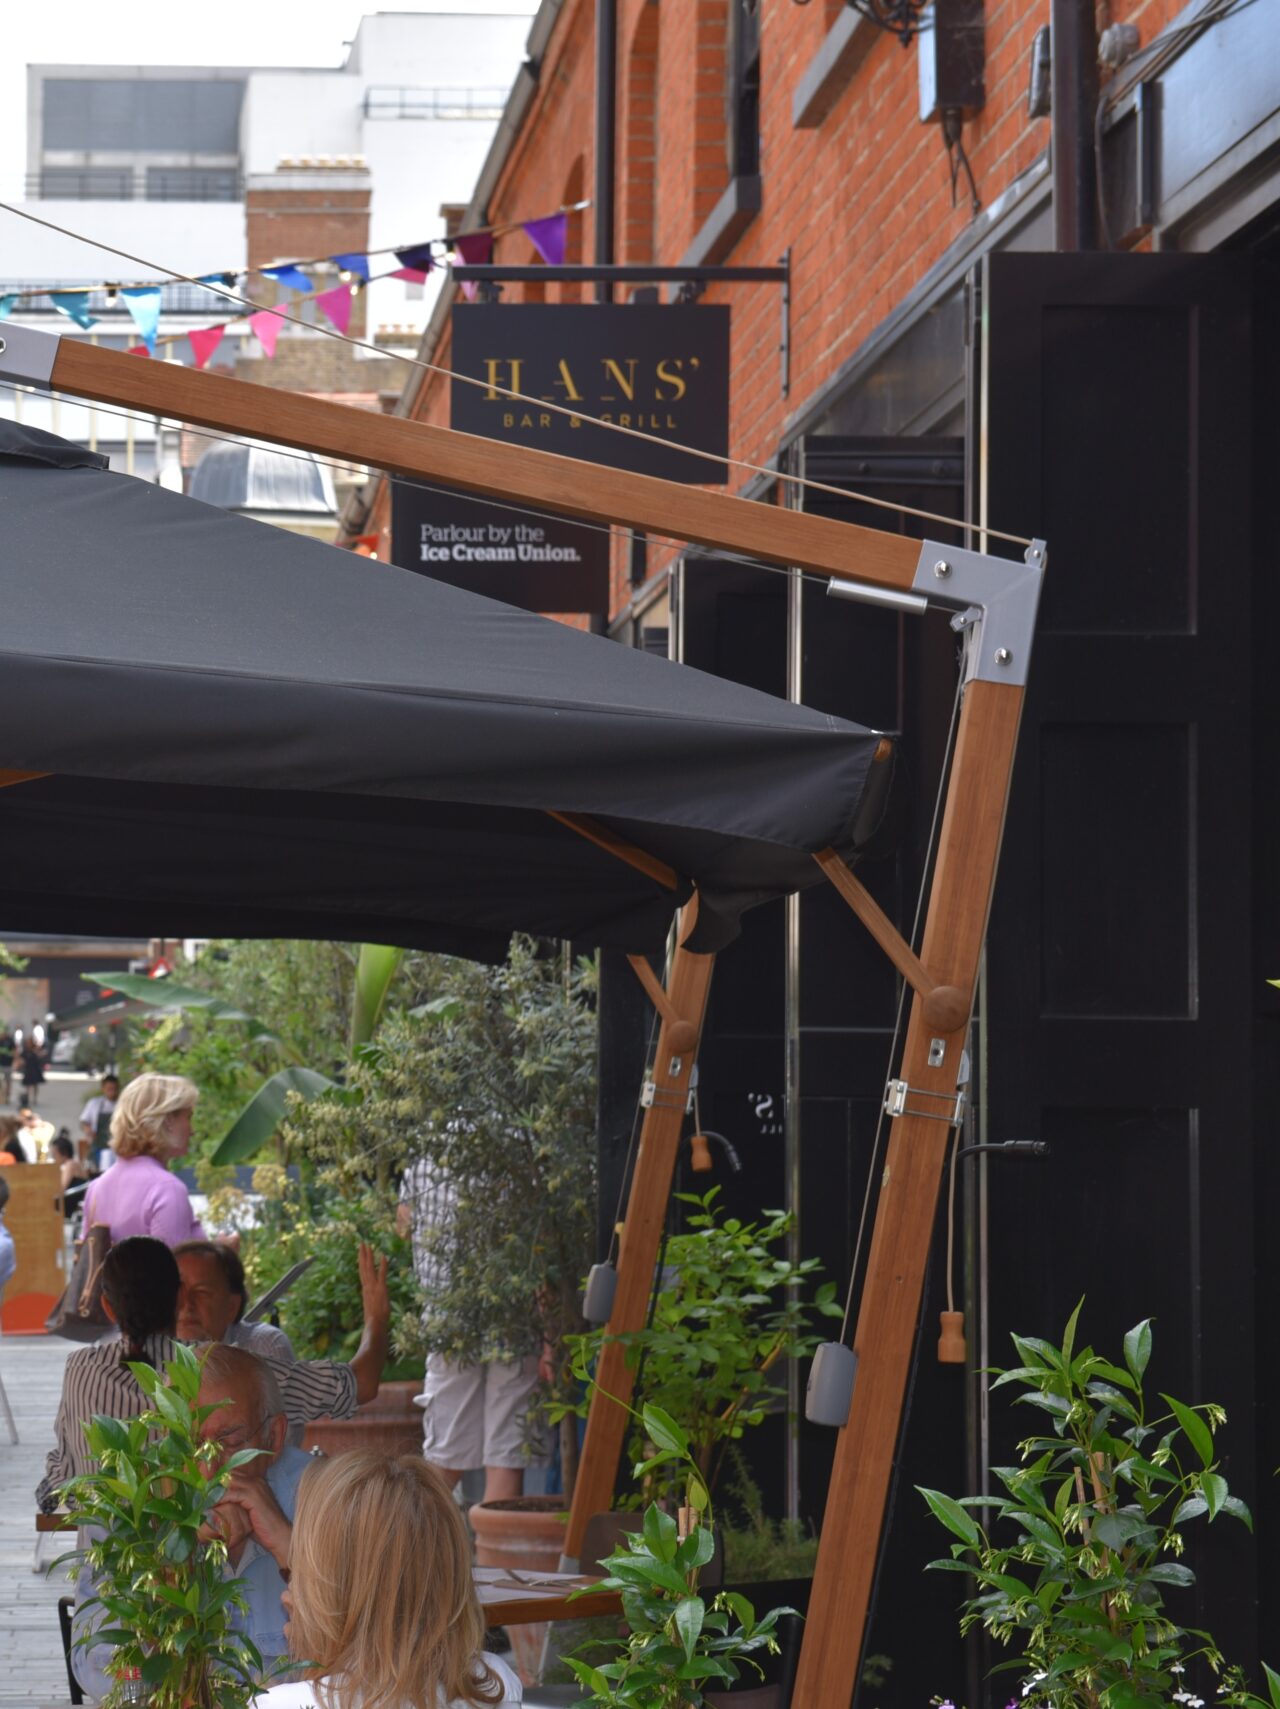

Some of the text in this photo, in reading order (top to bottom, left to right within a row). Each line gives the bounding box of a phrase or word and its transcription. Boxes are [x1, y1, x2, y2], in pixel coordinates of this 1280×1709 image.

[503, 413, 678, 429] BAR & GRILL
[420, 524, 545, 545] Parlour by the
[420, 543, 582, 561] Ice Cream Union.
